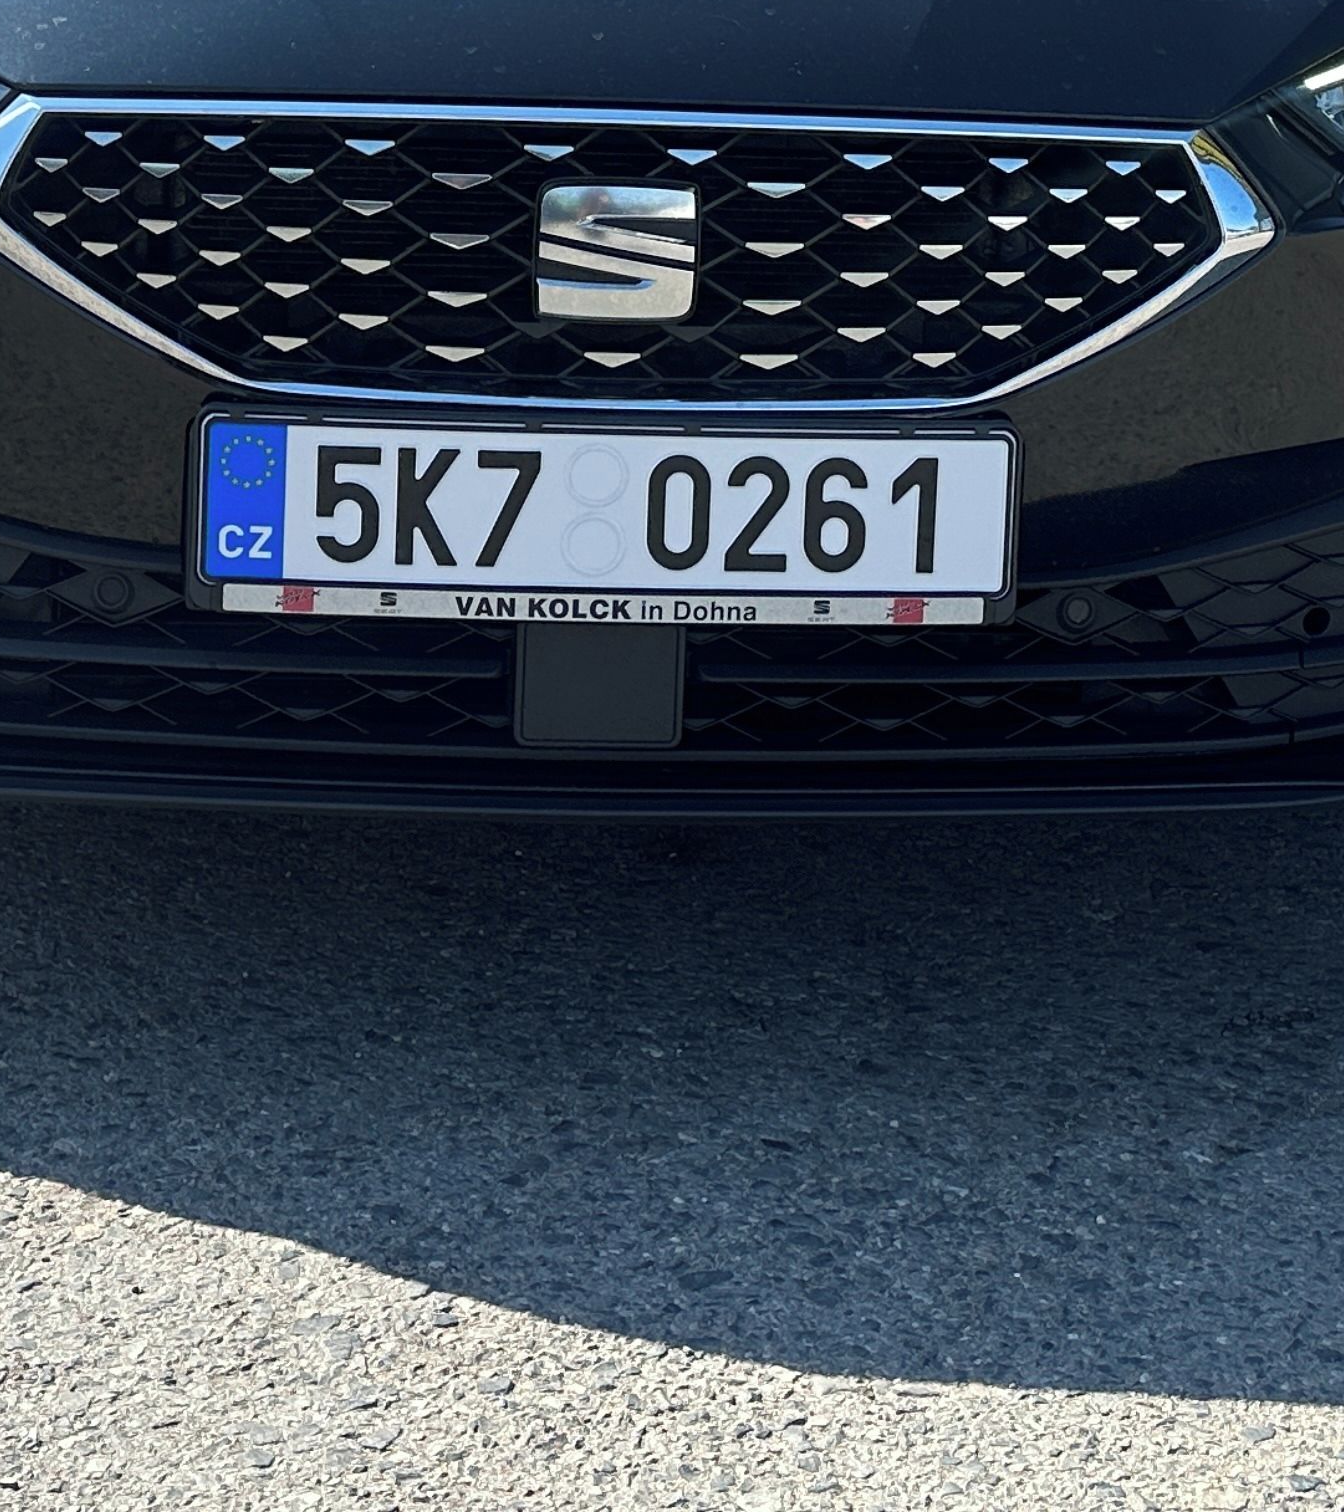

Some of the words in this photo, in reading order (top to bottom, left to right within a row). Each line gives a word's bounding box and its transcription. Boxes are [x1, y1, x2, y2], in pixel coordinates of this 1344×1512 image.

[316, 445, 542, 567] 5K7
[646, 454, 939, 574] 0261
[218, 524, 273, 559] CZ
[455, 596, 517, 618] VAN
[528, 598, 632, 620] KOLCK
[641, 600, 663, 620] in
[673, 601, 757, 621] Dohna
